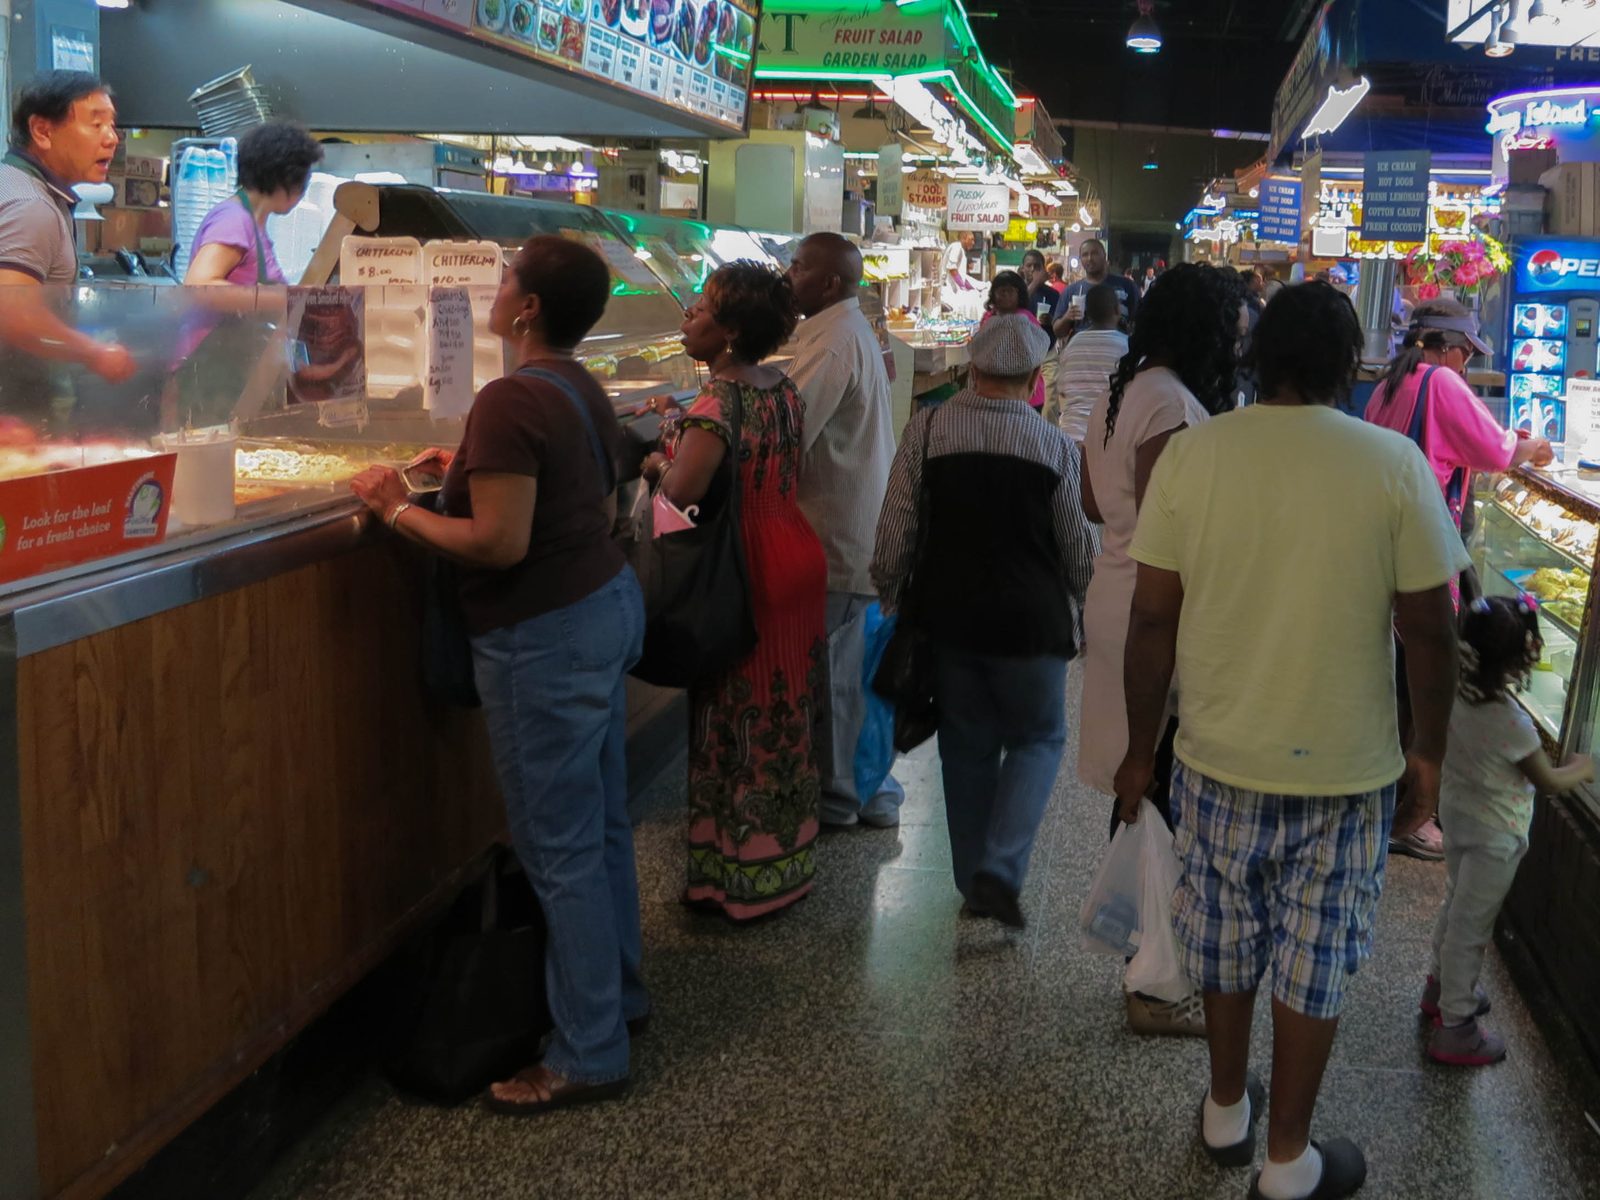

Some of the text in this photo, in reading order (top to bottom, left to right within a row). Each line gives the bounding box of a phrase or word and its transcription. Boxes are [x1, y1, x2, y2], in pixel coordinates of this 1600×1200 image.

[834, 29, 923, 45] FRUIT SALAD
[823, 52, 927, 69] GARDEN SALAD
[1377, 161, 1416, 172] ICE CREAM
[1378, 177, 1414, 187] HOT DOGS
[917, 184, 943, 195] FOOD
[953, 189, 985, 200] FRESH
[908, 193, 947, 206] STAMPS
[1366, 192, 1425, 202] FRESH LEMONADE
[1368, 207, 1422, 217] COTTON CANDY
[951, 212, 975, 223] FRUIT
[977, 213, 1005, 224] SALAD
[1365, 222, 1423, 232] FRESH COCONUT
[1559, 258, 1600, 277] PE
[22, 499, 112, 530] Look for the leaf
[16, 534, 34, 551] for
[36, 536, 44, 546] a
[46, 525, 75, 545] fresh
[76, 521, 111, 537] choice
